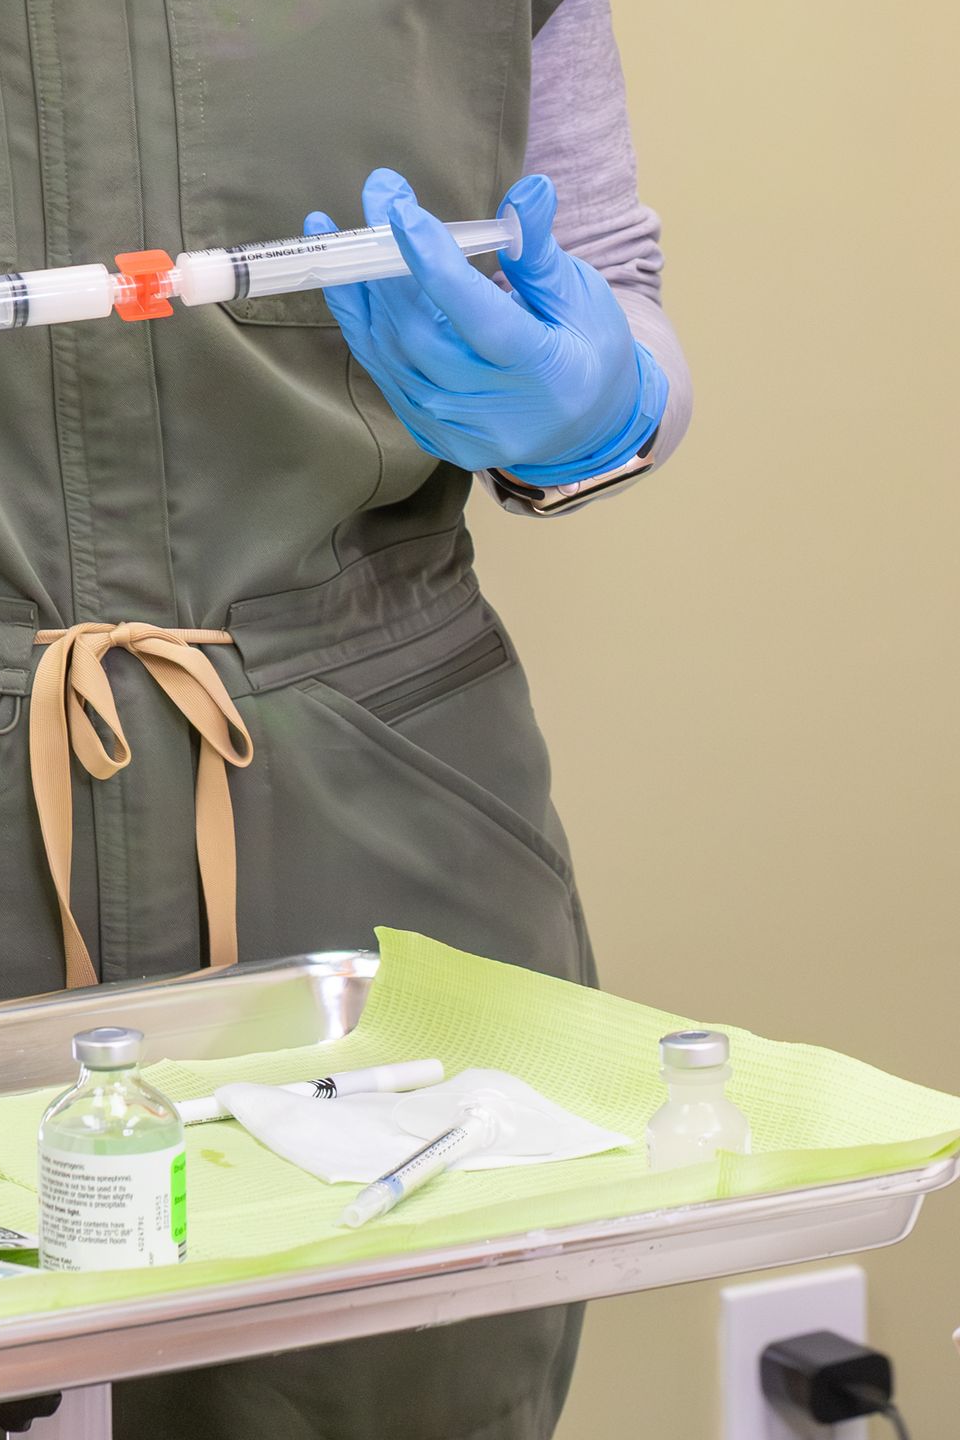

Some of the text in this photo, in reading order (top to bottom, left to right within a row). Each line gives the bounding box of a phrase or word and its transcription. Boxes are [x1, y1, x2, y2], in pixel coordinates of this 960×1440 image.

[241, 244, 328, 262] OR SINGLE USE
